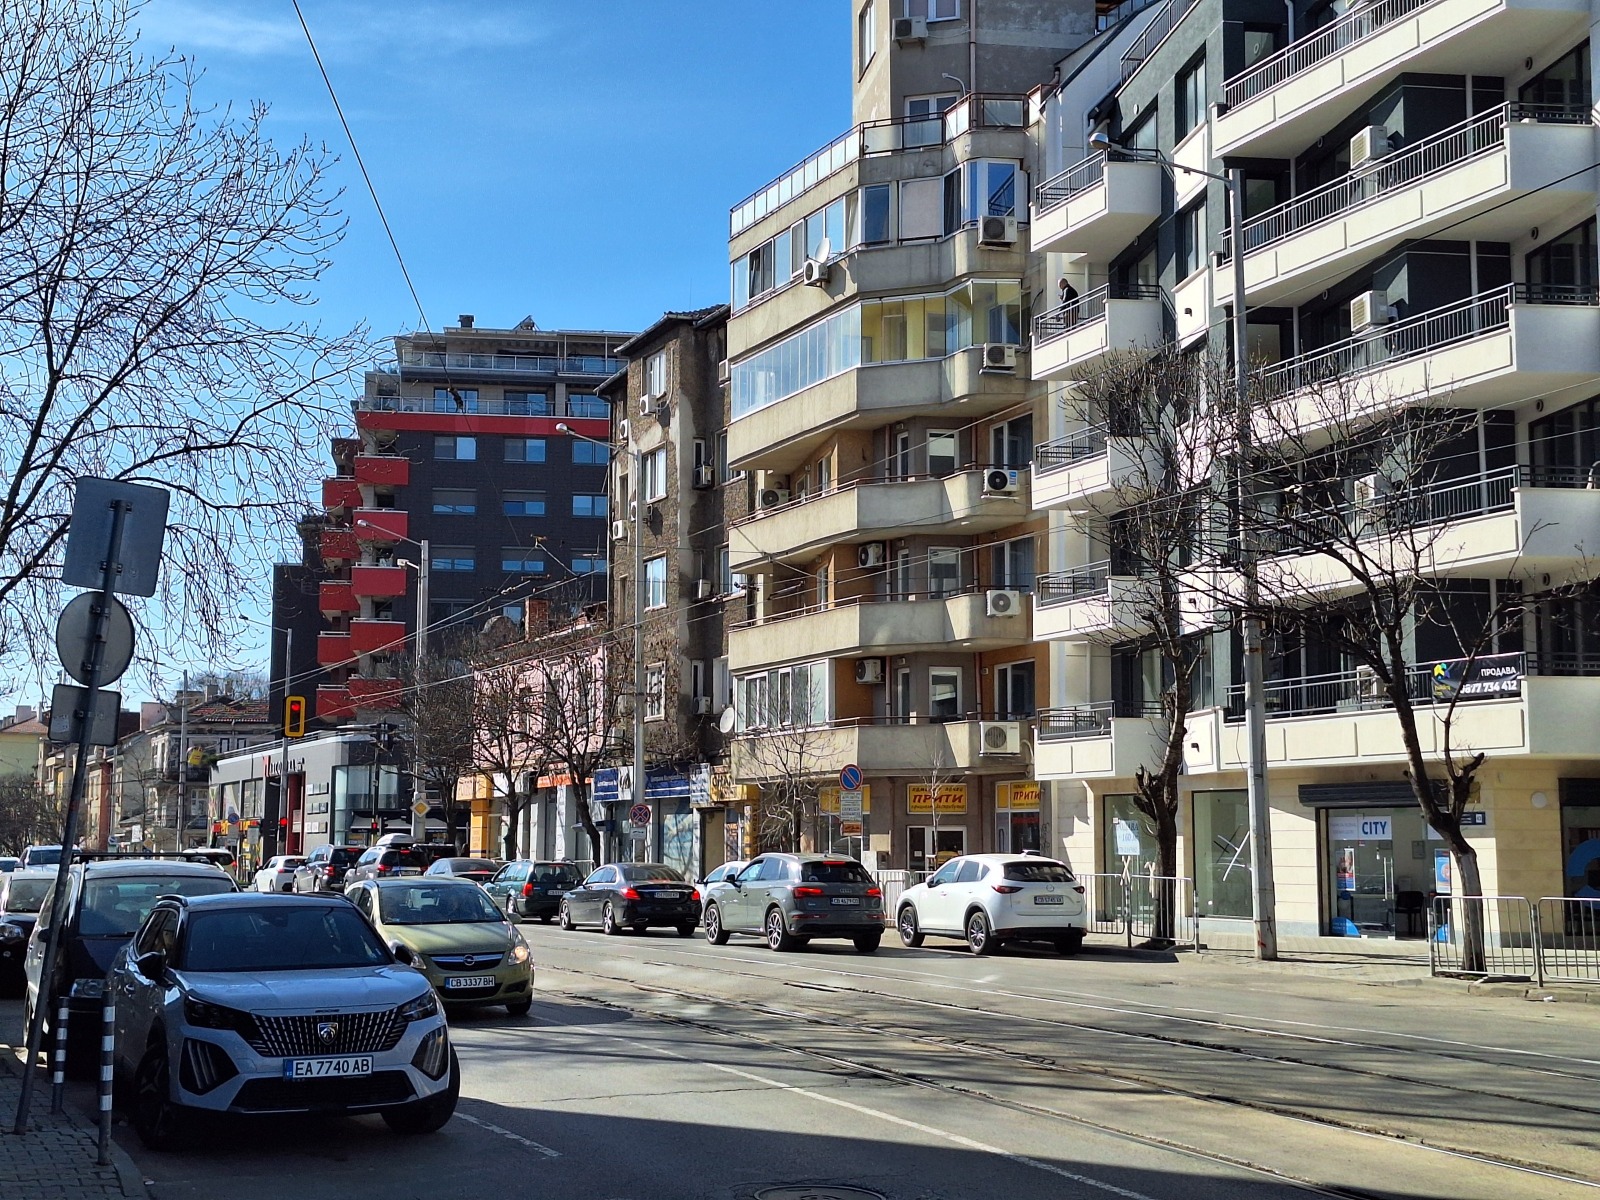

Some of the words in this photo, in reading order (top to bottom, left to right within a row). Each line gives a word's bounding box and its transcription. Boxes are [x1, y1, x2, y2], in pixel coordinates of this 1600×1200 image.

[1481, 666, 1516, 677] ПРОДАВА
[1483, 682, 1499, 692] 734
[1501, 680, 1517, 690] 412
[912, 794, 964, 803] ПРИТИ
[1013, 790, 1040, 801] ПРИТИ
[1362, 821, 1387, 835] CITY
[451, 979, 461, 987] CB
[463, 978, 482, 986] 3337
[483, 977, 493, 985] BH
[295, 1062, 313, 1075] EA
[316, 1060, 349, 1074] 7740
[352, 1059, 369, 1073] AB
